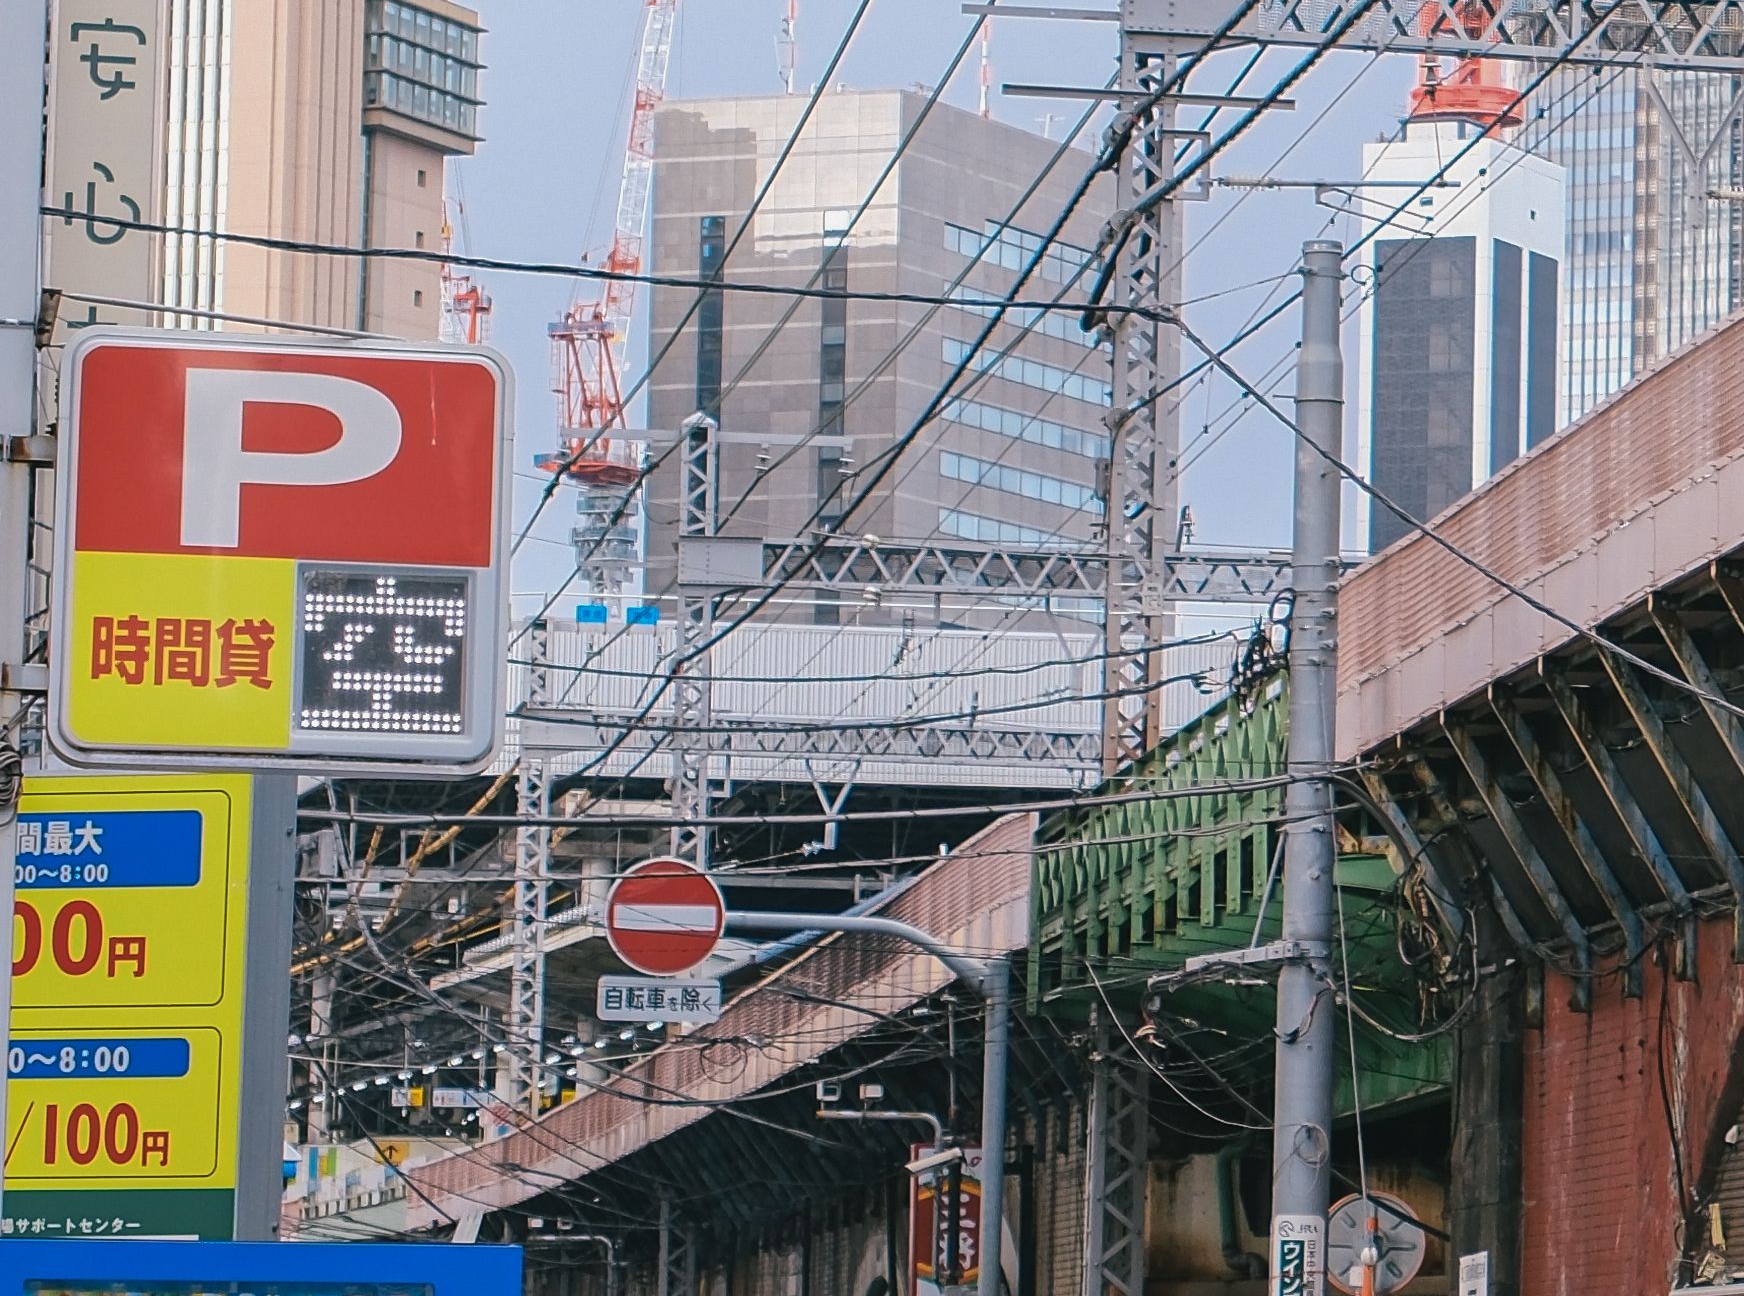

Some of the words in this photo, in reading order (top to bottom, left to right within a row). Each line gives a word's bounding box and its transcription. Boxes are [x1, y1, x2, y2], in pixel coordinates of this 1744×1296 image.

[65, 18, 147, 328] 安心
[180, 367, 402, 548] P
[90, 614, 276, 690] 時間貸
[301, 575, 466, 734] 空
[604, 986, 713, 1013] 自転車を除く
